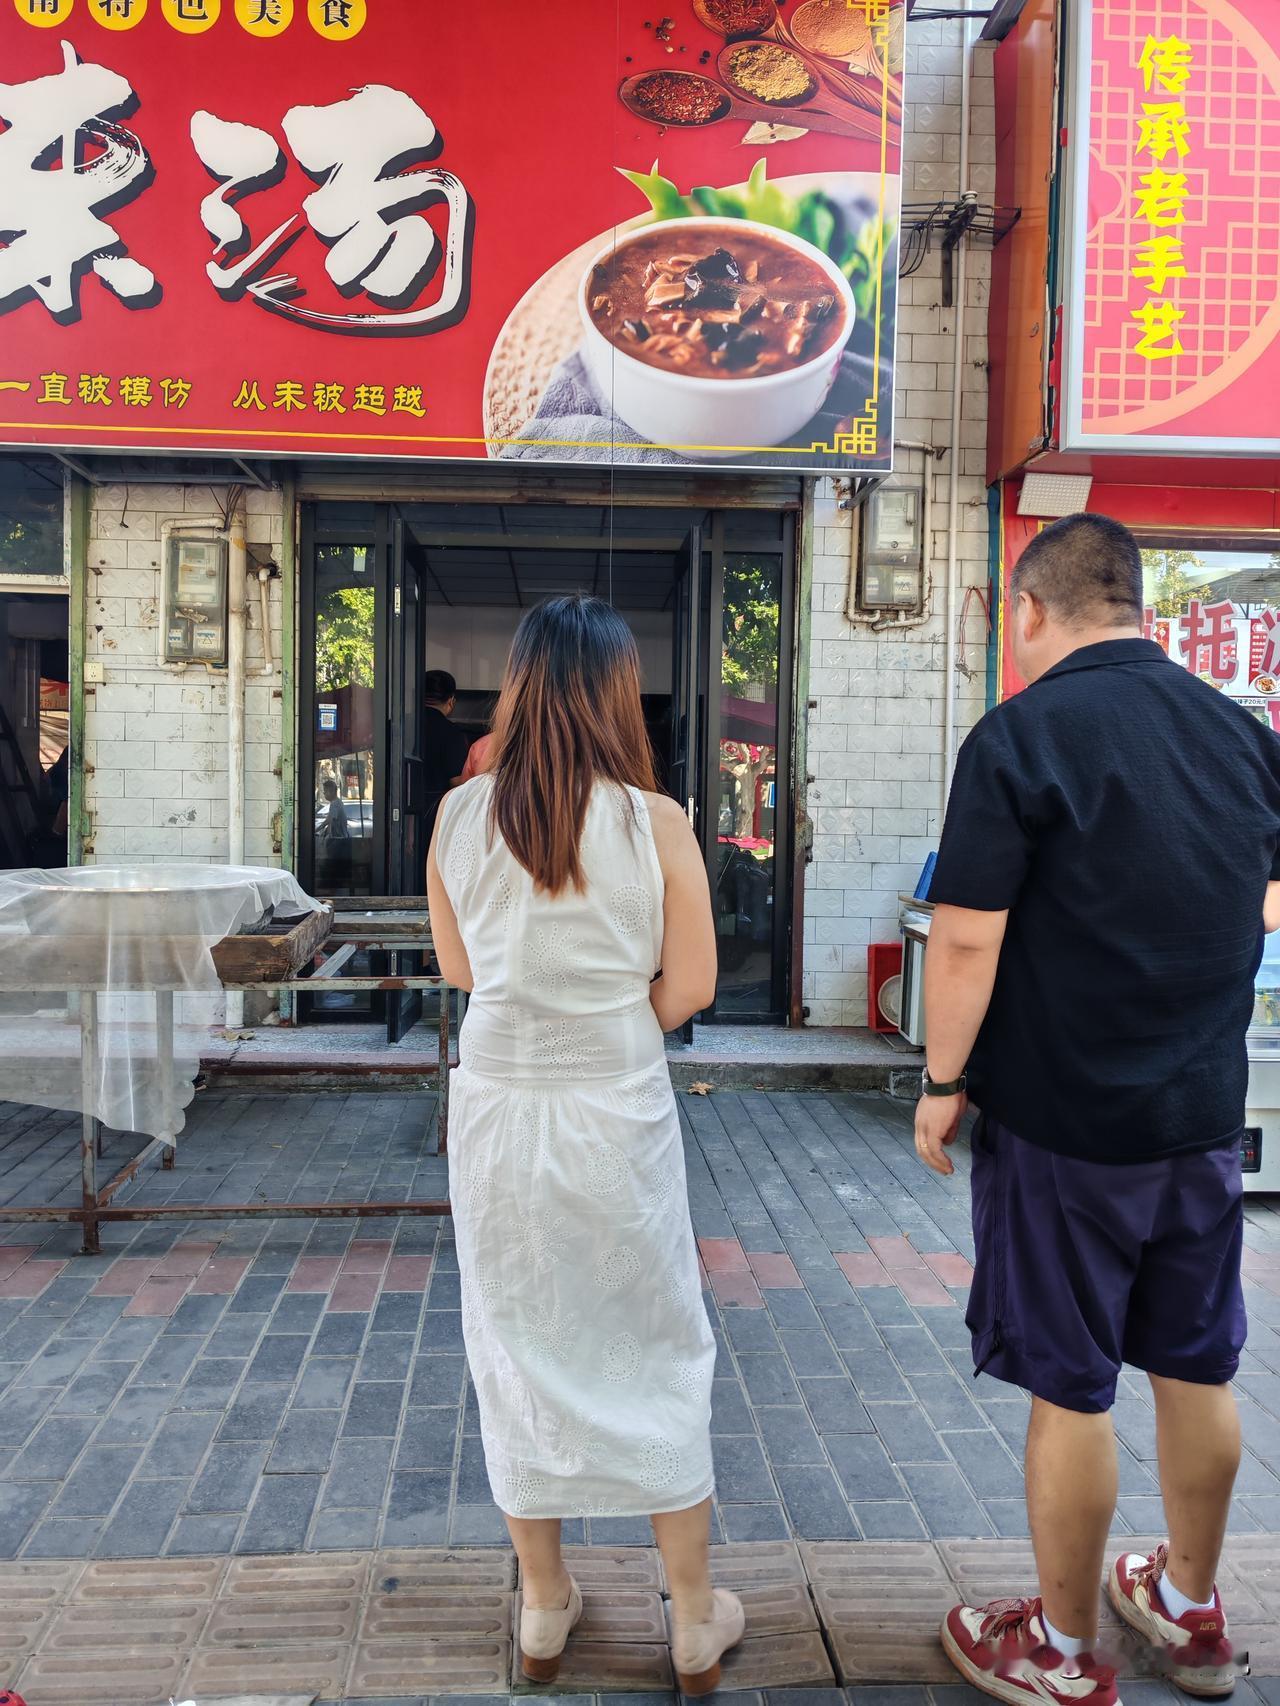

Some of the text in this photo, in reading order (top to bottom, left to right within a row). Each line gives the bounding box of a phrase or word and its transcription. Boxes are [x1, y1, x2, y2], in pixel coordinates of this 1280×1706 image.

[1130, 33, 1194, 361] 传承老手艺
[0, 371, 427, 418] 一直被模仿 从未被超越
